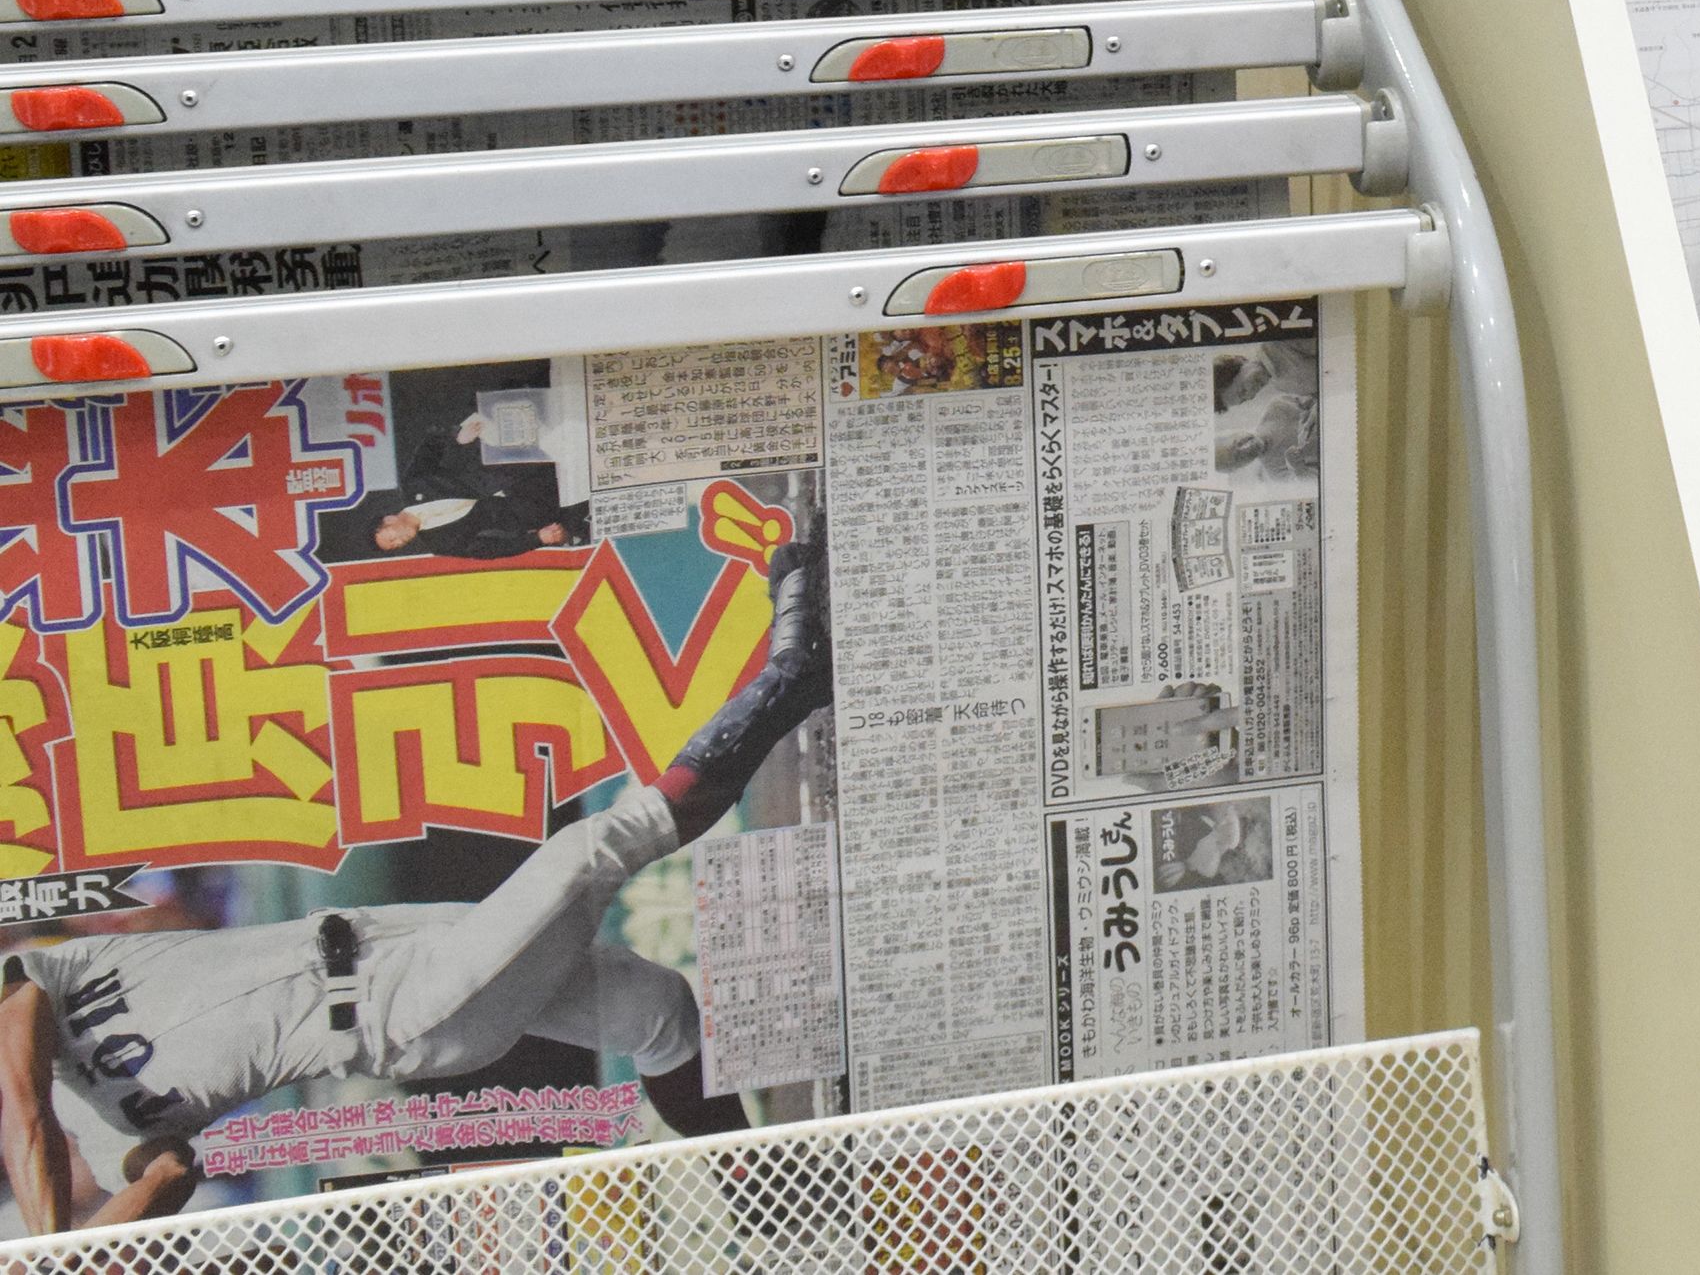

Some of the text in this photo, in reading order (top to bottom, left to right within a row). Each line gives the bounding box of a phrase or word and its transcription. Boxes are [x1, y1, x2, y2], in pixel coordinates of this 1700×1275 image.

[1034, 304, 1315, 352] スマホ&タブレット
[285, 465, 342, 495] 監督
[129, 623, 236, 651] 大阪桐蔭高
[849, 697, 1026, 731] U18も密着、天命待つ
[1074, 817, 1096, 1058] きもかわ海洋生物・ウミウシ満載!
[1057, 954, 1071, 1013] シリーズ
[1288, 947, 1302, 1019] オールカラー
